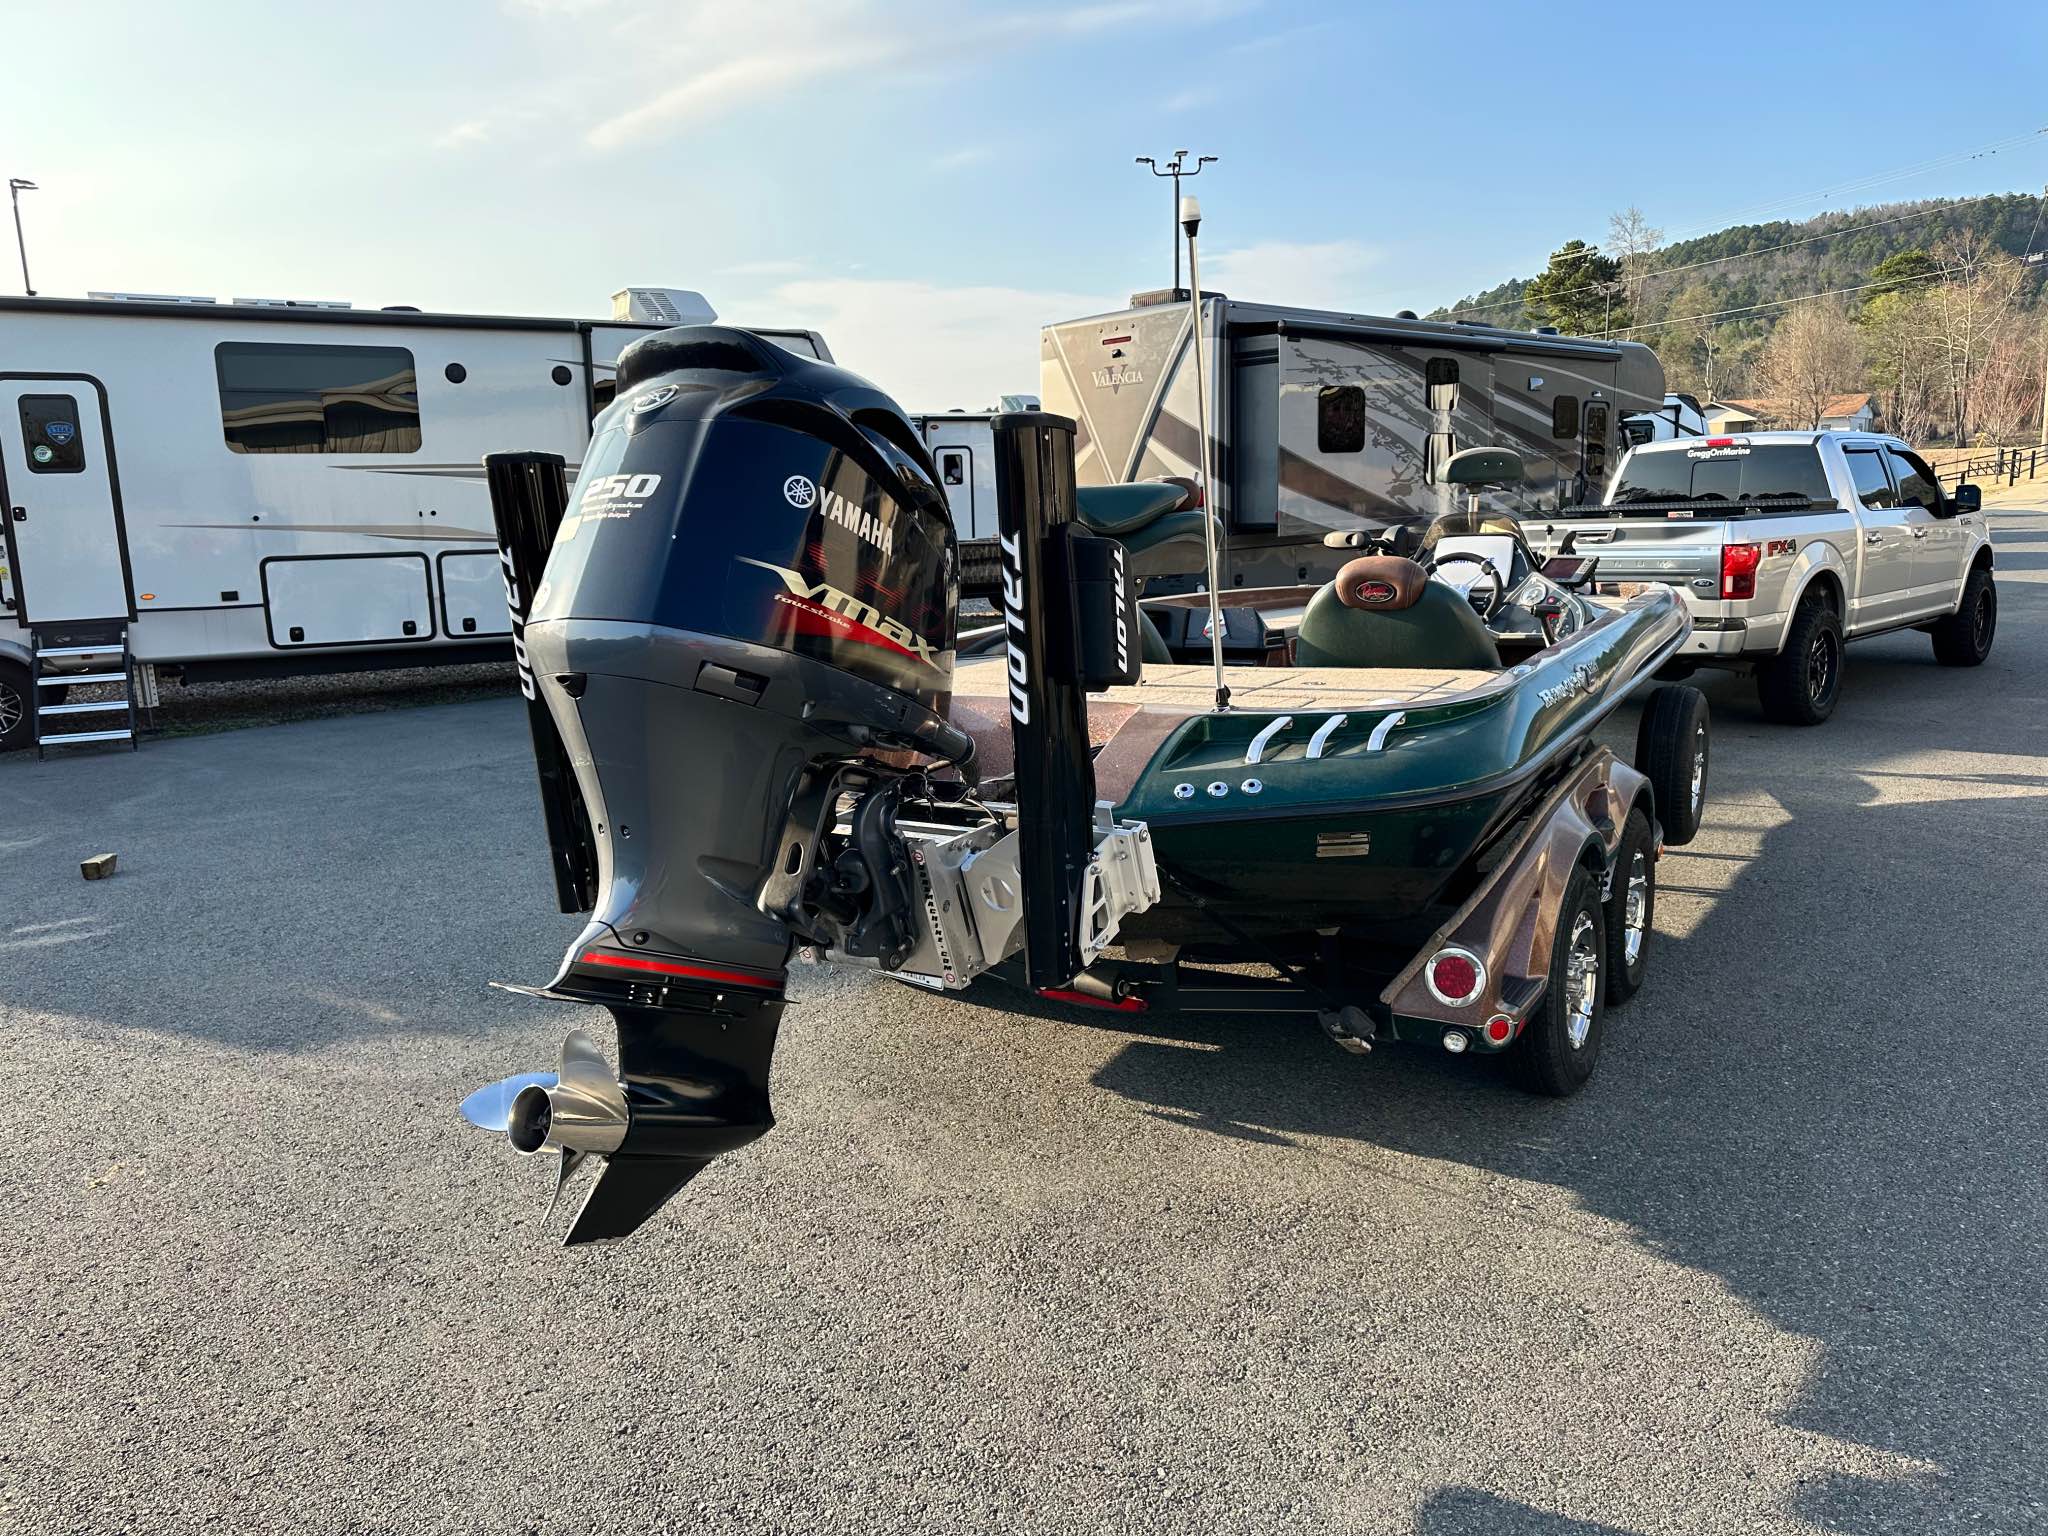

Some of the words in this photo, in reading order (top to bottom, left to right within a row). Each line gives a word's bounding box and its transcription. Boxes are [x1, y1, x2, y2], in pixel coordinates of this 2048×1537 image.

[1091, 371, 1144, 388] VALENCIA
[1687, 447, 1751, 459] GreggOrrMarine
[580, 474, 661, 505] 250
[819, 486, 893, 556] YAMAHA
[1768, 539, 1796, 557] FX4
